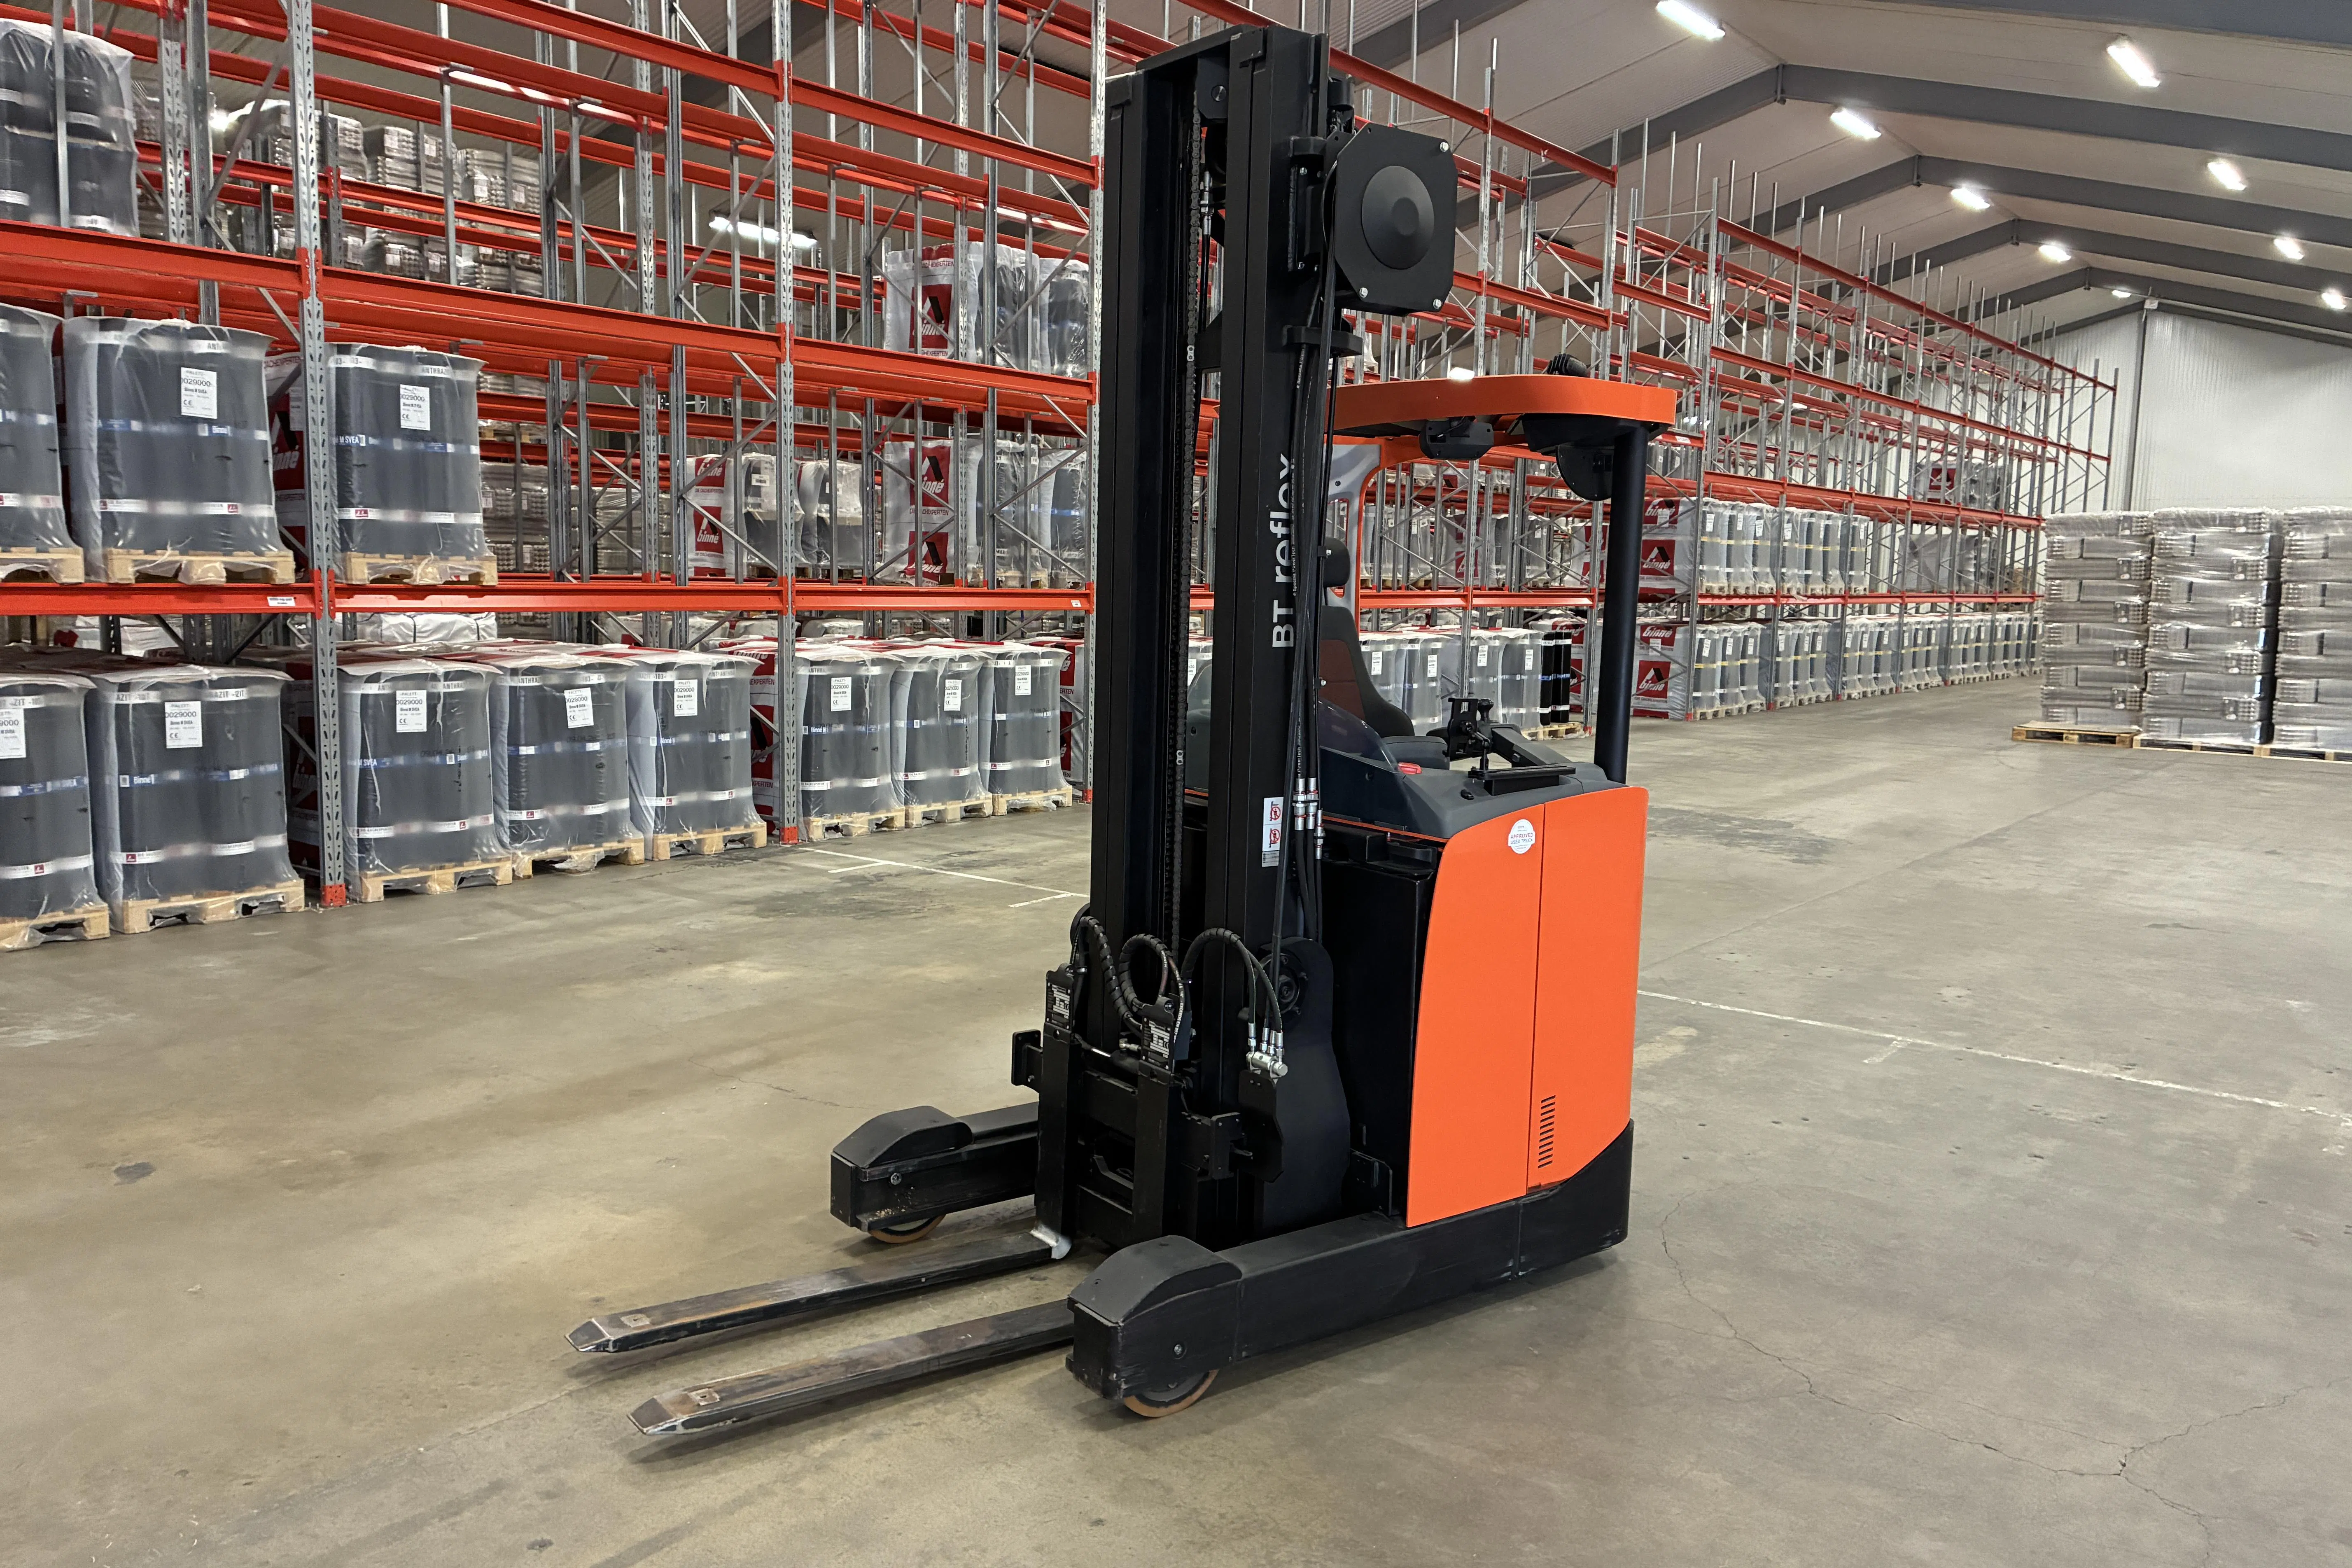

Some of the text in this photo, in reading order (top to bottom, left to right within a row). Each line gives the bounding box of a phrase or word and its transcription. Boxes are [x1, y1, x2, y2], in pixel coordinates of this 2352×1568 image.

[912, 320, 945, 335] inné
[345, 436, 359, 444] SVEA
[922, 476, 945, 493] inné
[1272, 600, 1294, 647] BT
